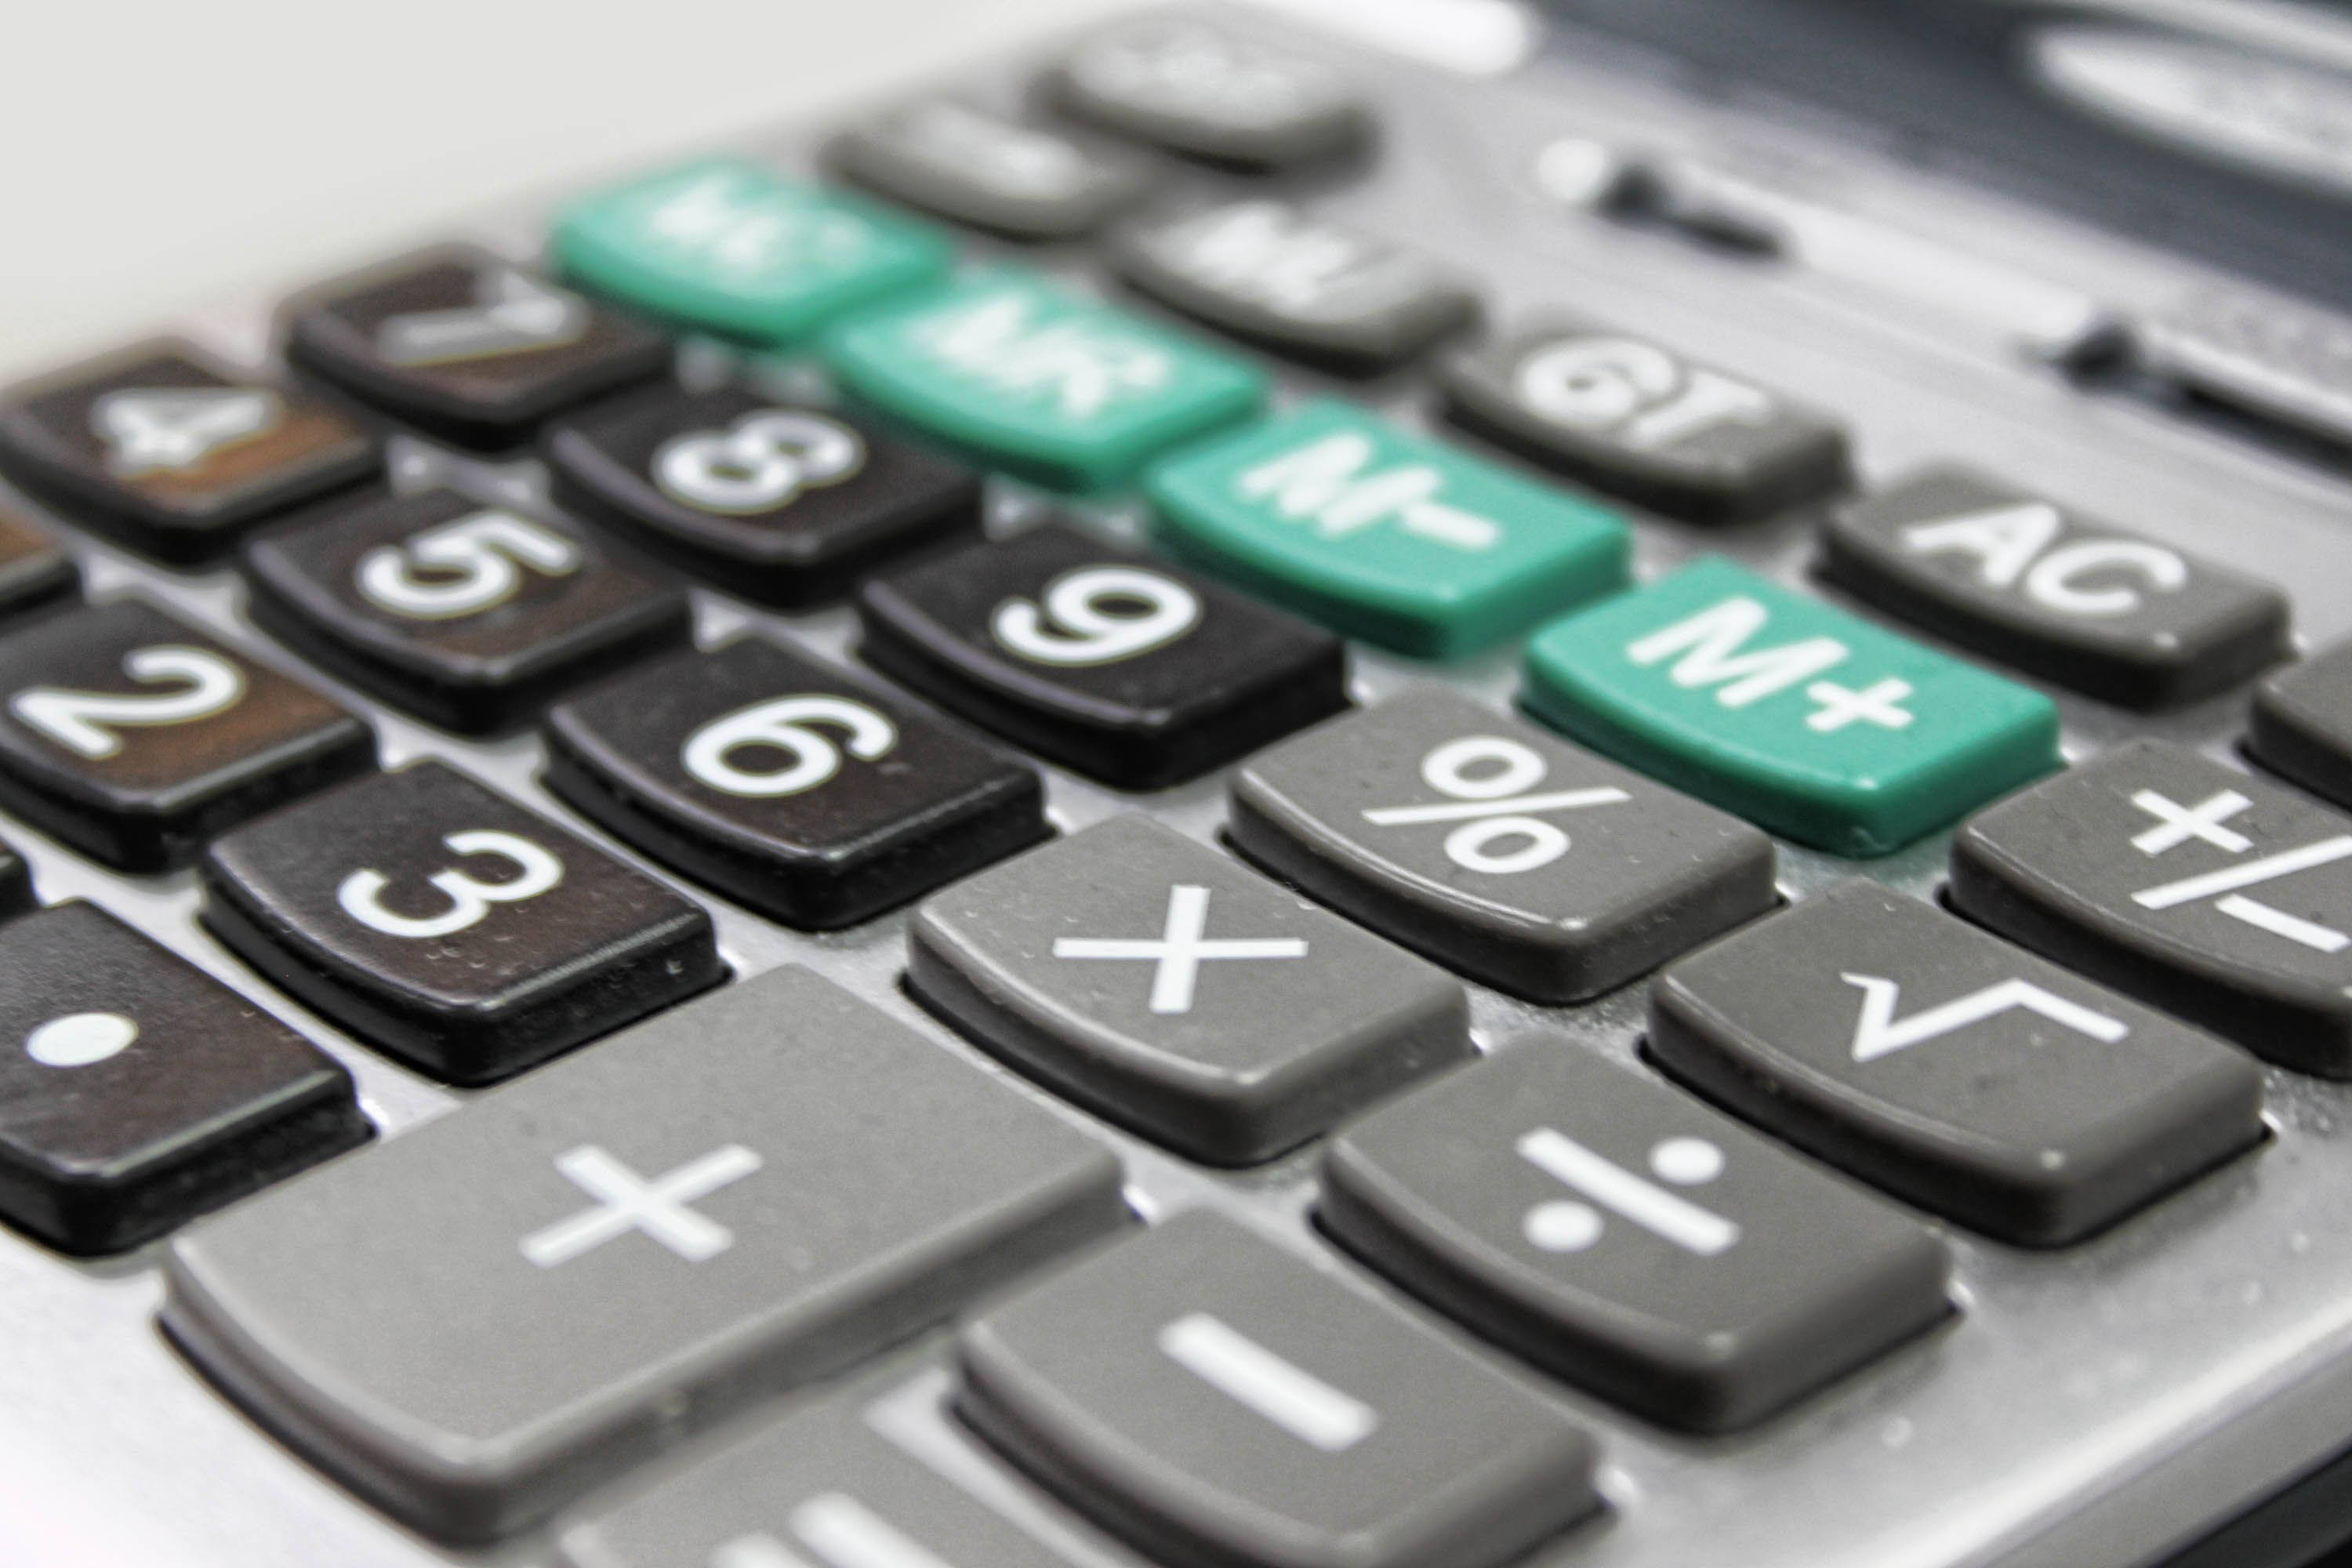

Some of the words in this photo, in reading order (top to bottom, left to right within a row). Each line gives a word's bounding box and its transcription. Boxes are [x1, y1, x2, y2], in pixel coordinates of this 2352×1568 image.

[375, 265, 590, 365] 7
[91, 388, 281, 474] 4
[1513, 335, 1775, 449] GT
[652, 409, 865, 514] 8
[355, 510, 581, 617] 5
[1905, 503, 2187, 615] AC
[993, 565, 1201, 666] 9
[1625, 597, 1914, 732] M+
[9, 646, 243, 759] 2
[682, 692, 898, 797] 6
[1362, 735, 1632, 873] %
[338, 829, 564, 938] 3
